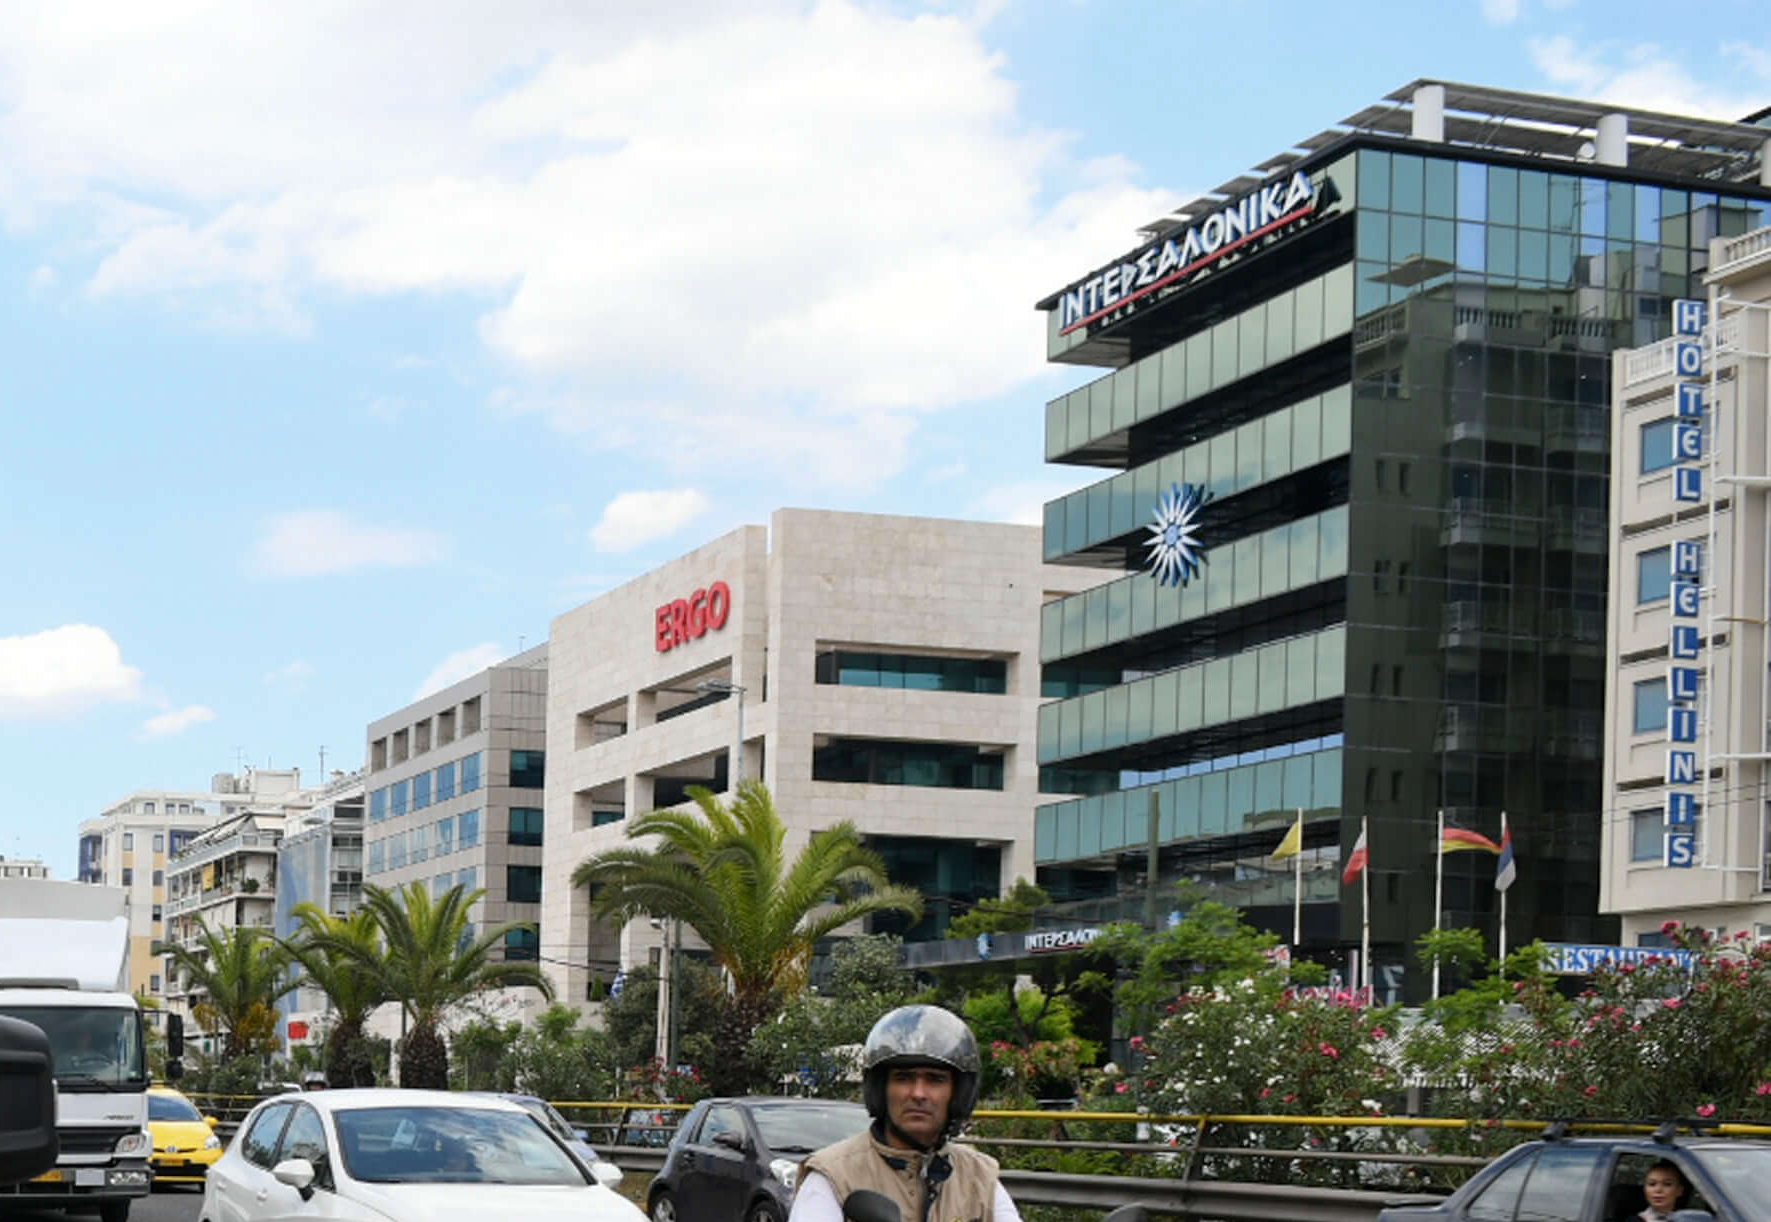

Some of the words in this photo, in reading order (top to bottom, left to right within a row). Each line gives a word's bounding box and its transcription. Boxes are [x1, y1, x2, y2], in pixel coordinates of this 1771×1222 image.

[1059, 169, 1313, 330] ΙΝΤΕΡΣΑΛΟΝΙΚΑ
[1680, 303, 1702, 499] HOTEL
[655, 581, 731, 653] ERGO
[1671, 544, 1699, 865] HELLINIS
